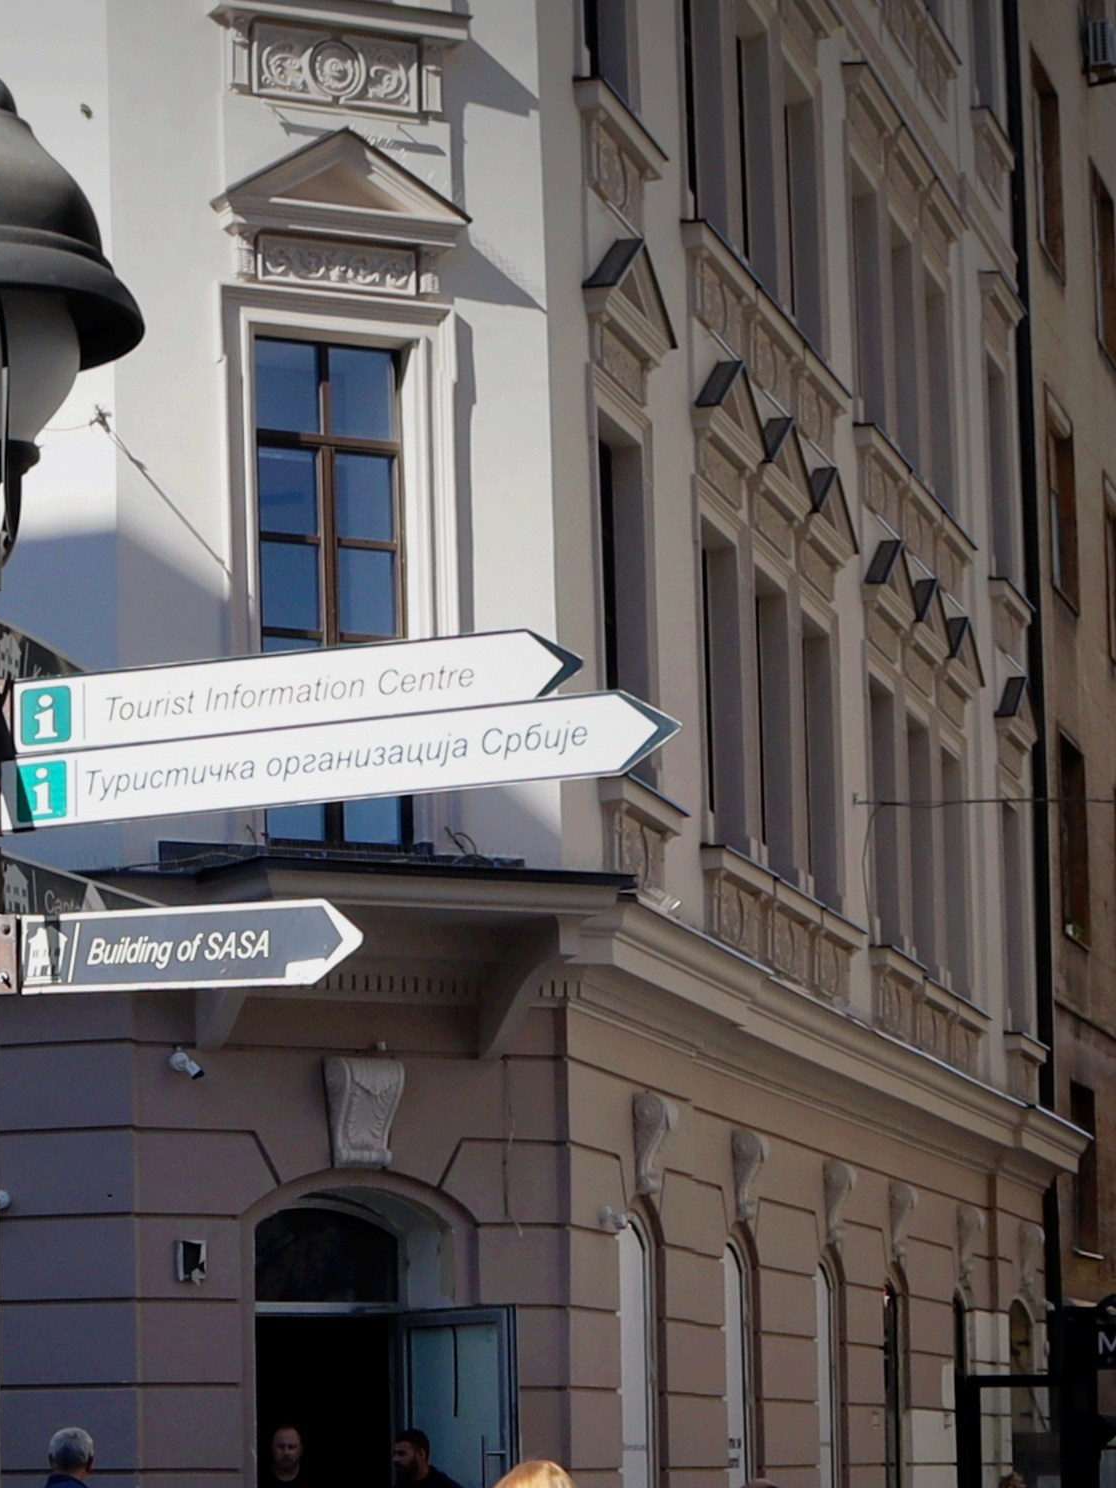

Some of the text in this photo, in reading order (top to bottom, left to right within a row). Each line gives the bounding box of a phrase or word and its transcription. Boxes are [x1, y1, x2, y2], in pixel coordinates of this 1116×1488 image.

[106, 689, 196, 722] Tourist
[205, 675, 365, 712] Information
[378, 664, 476, 696] Centre
[85, 759, 256, 802] Туристичка
[266, 732, 468, 783] организација
[481, 720, 589, 765] Србије
[87, 930, 270, 970] Building of SASA
